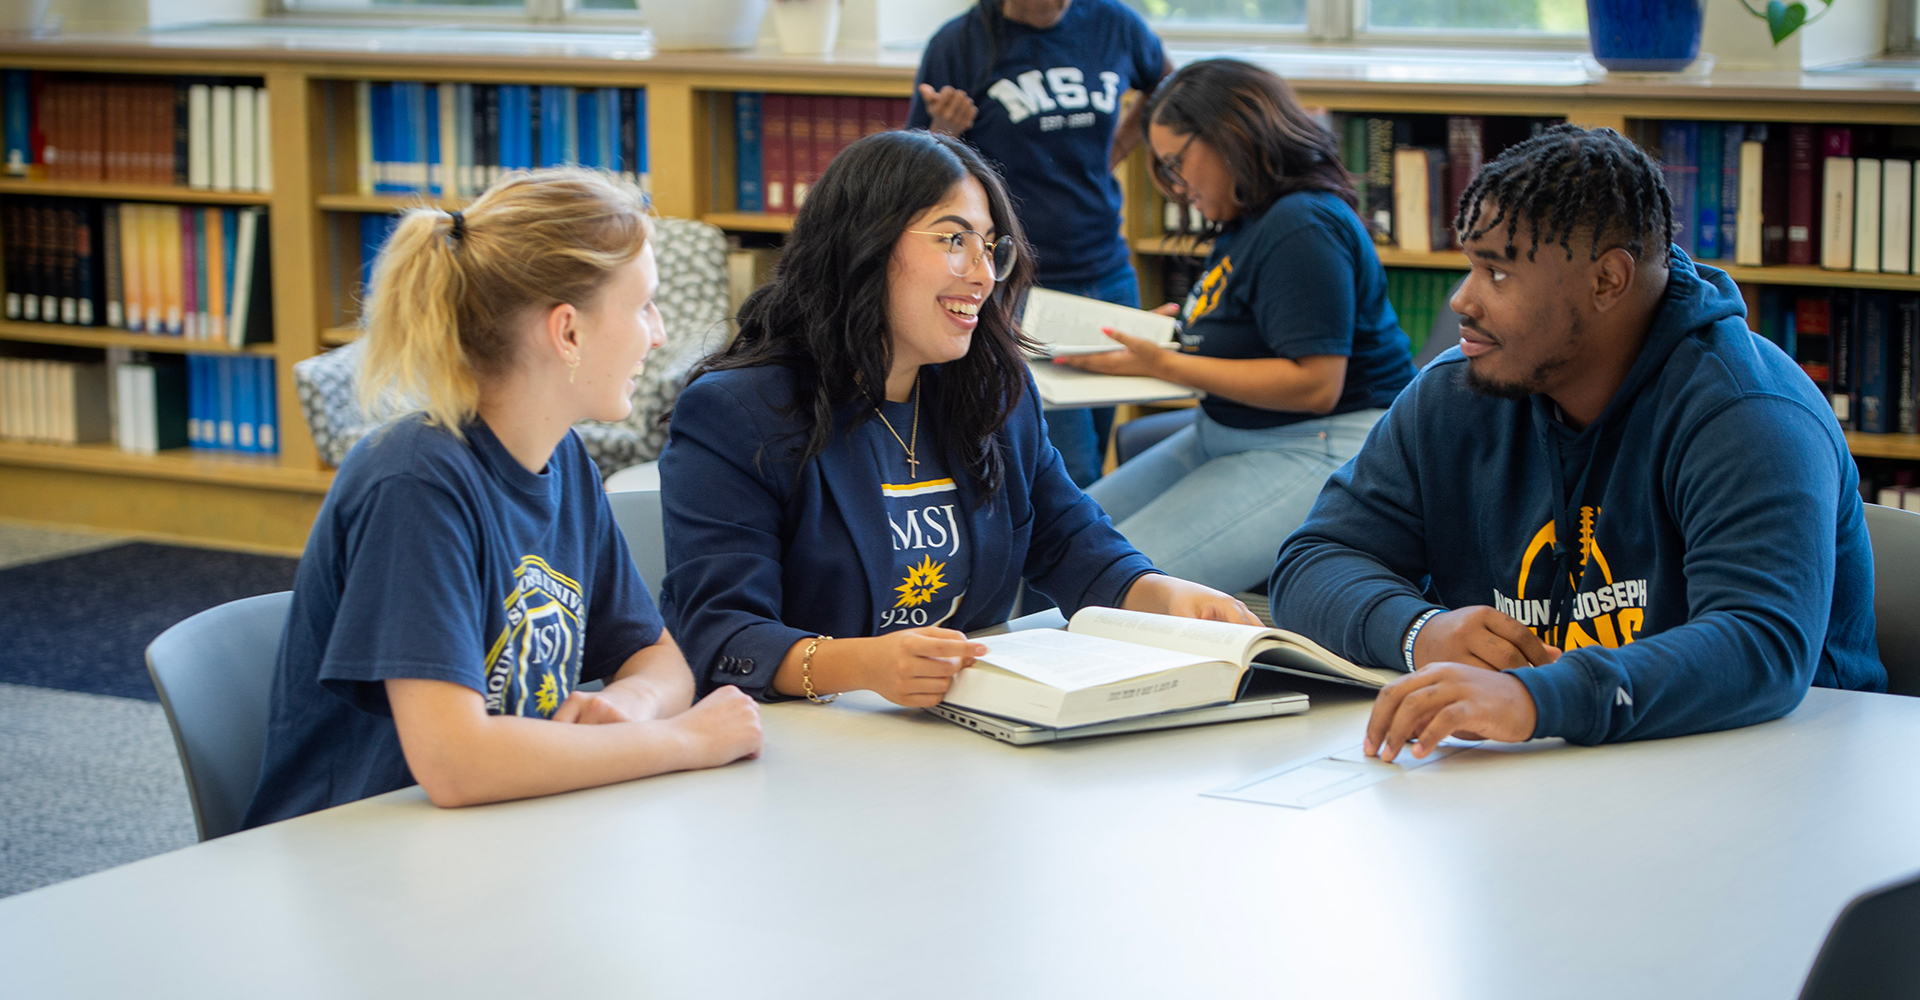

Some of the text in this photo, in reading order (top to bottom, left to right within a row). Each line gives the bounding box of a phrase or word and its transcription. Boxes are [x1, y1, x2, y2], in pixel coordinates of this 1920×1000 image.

[987, 66, 1120, 124] MSJ
[886, 504, 960, 557] MSJ
[879, 607, 928, 629] 920
[1573, 579, 1647, 621] JOSEPH
[485, 641, 514, 710] MOUN
